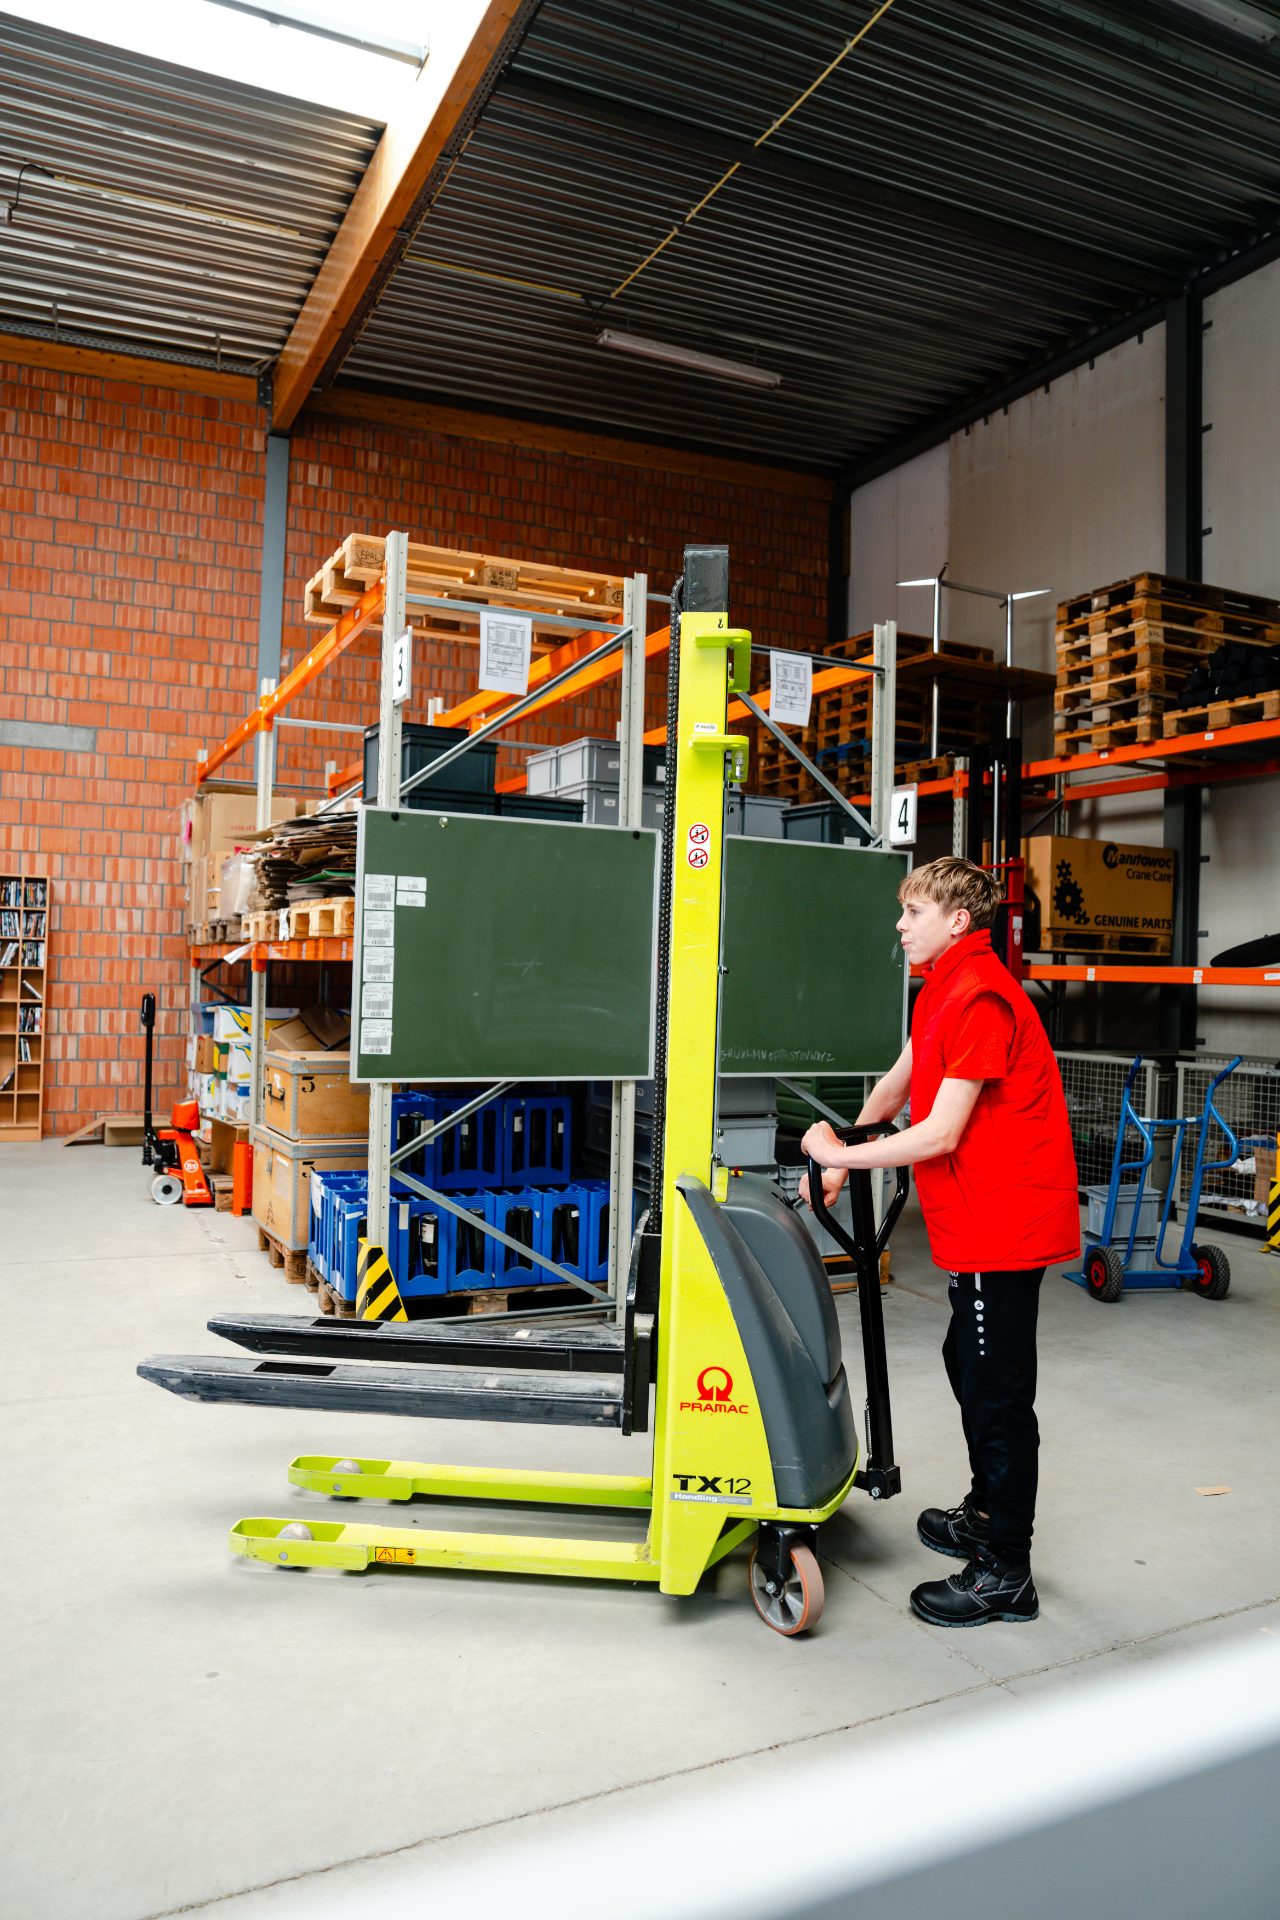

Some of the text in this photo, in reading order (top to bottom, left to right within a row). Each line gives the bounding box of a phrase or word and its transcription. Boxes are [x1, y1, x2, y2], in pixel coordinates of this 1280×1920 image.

[898, 798, 908, 834] 4
[1105, 847, 1172, 869] Manitowoc
[1126, 868, 1172, 882] Crane Care
[1094, 914, 1172, 929] GENUINE PARTS
[680, 1402, 748, 1414] PRAMAC
